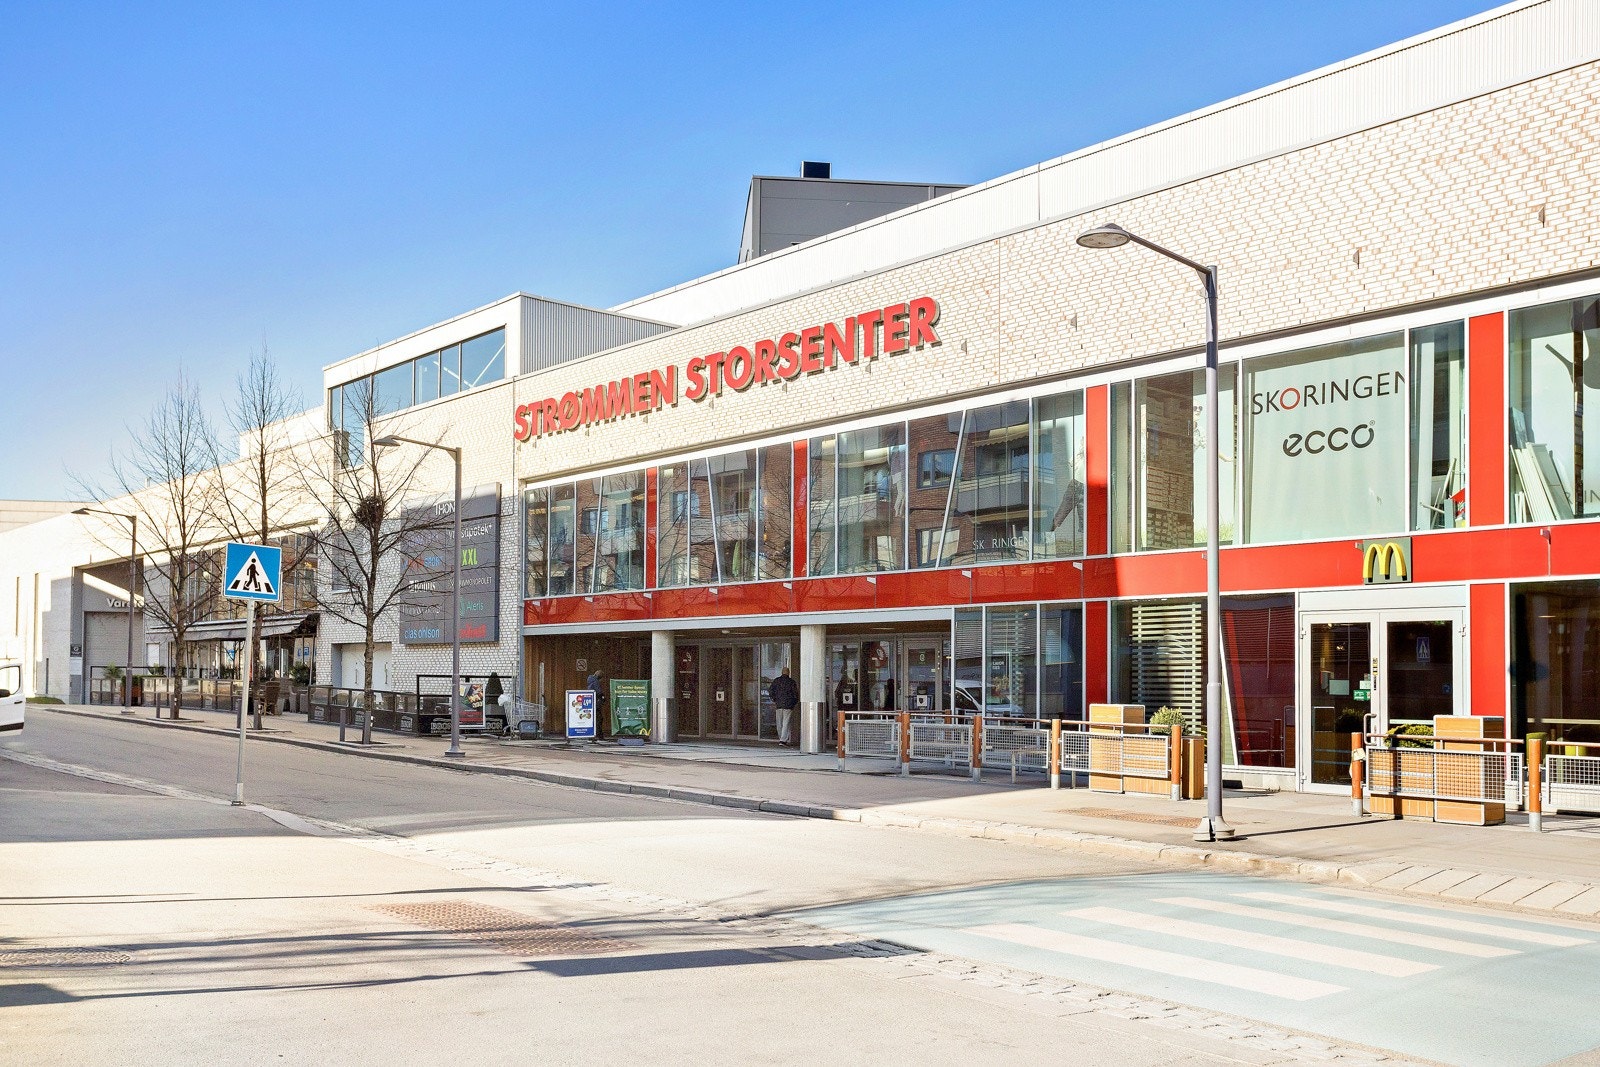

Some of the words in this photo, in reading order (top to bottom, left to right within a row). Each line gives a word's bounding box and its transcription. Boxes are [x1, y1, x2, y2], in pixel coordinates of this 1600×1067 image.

[514, 365, 677, 441] STRØMMEN
[685, 296, 940, 402] STORSENTER
[1283, 424, 1375, 457] ecco
[461, 548, 478, 567] XXL
